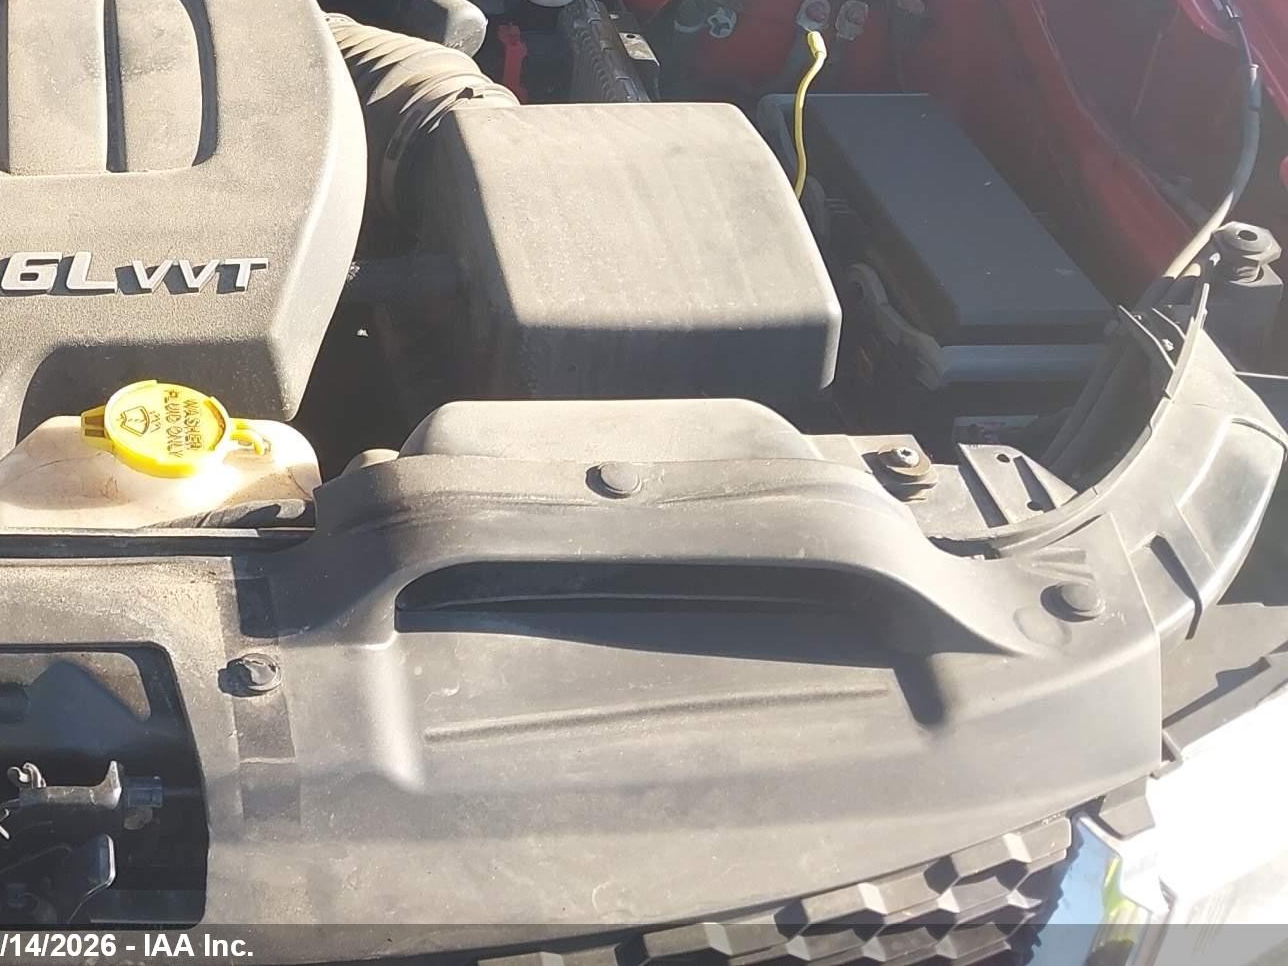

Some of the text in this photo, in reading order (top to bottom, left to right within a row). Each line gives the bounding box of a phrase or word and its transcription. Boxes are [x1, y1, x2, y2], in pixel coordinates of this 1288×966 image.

[131, 257, 269, 293] VVT
[164, 389, 184, 458] FLUID ONLY
[183, 400, 202, 450] WASHER
